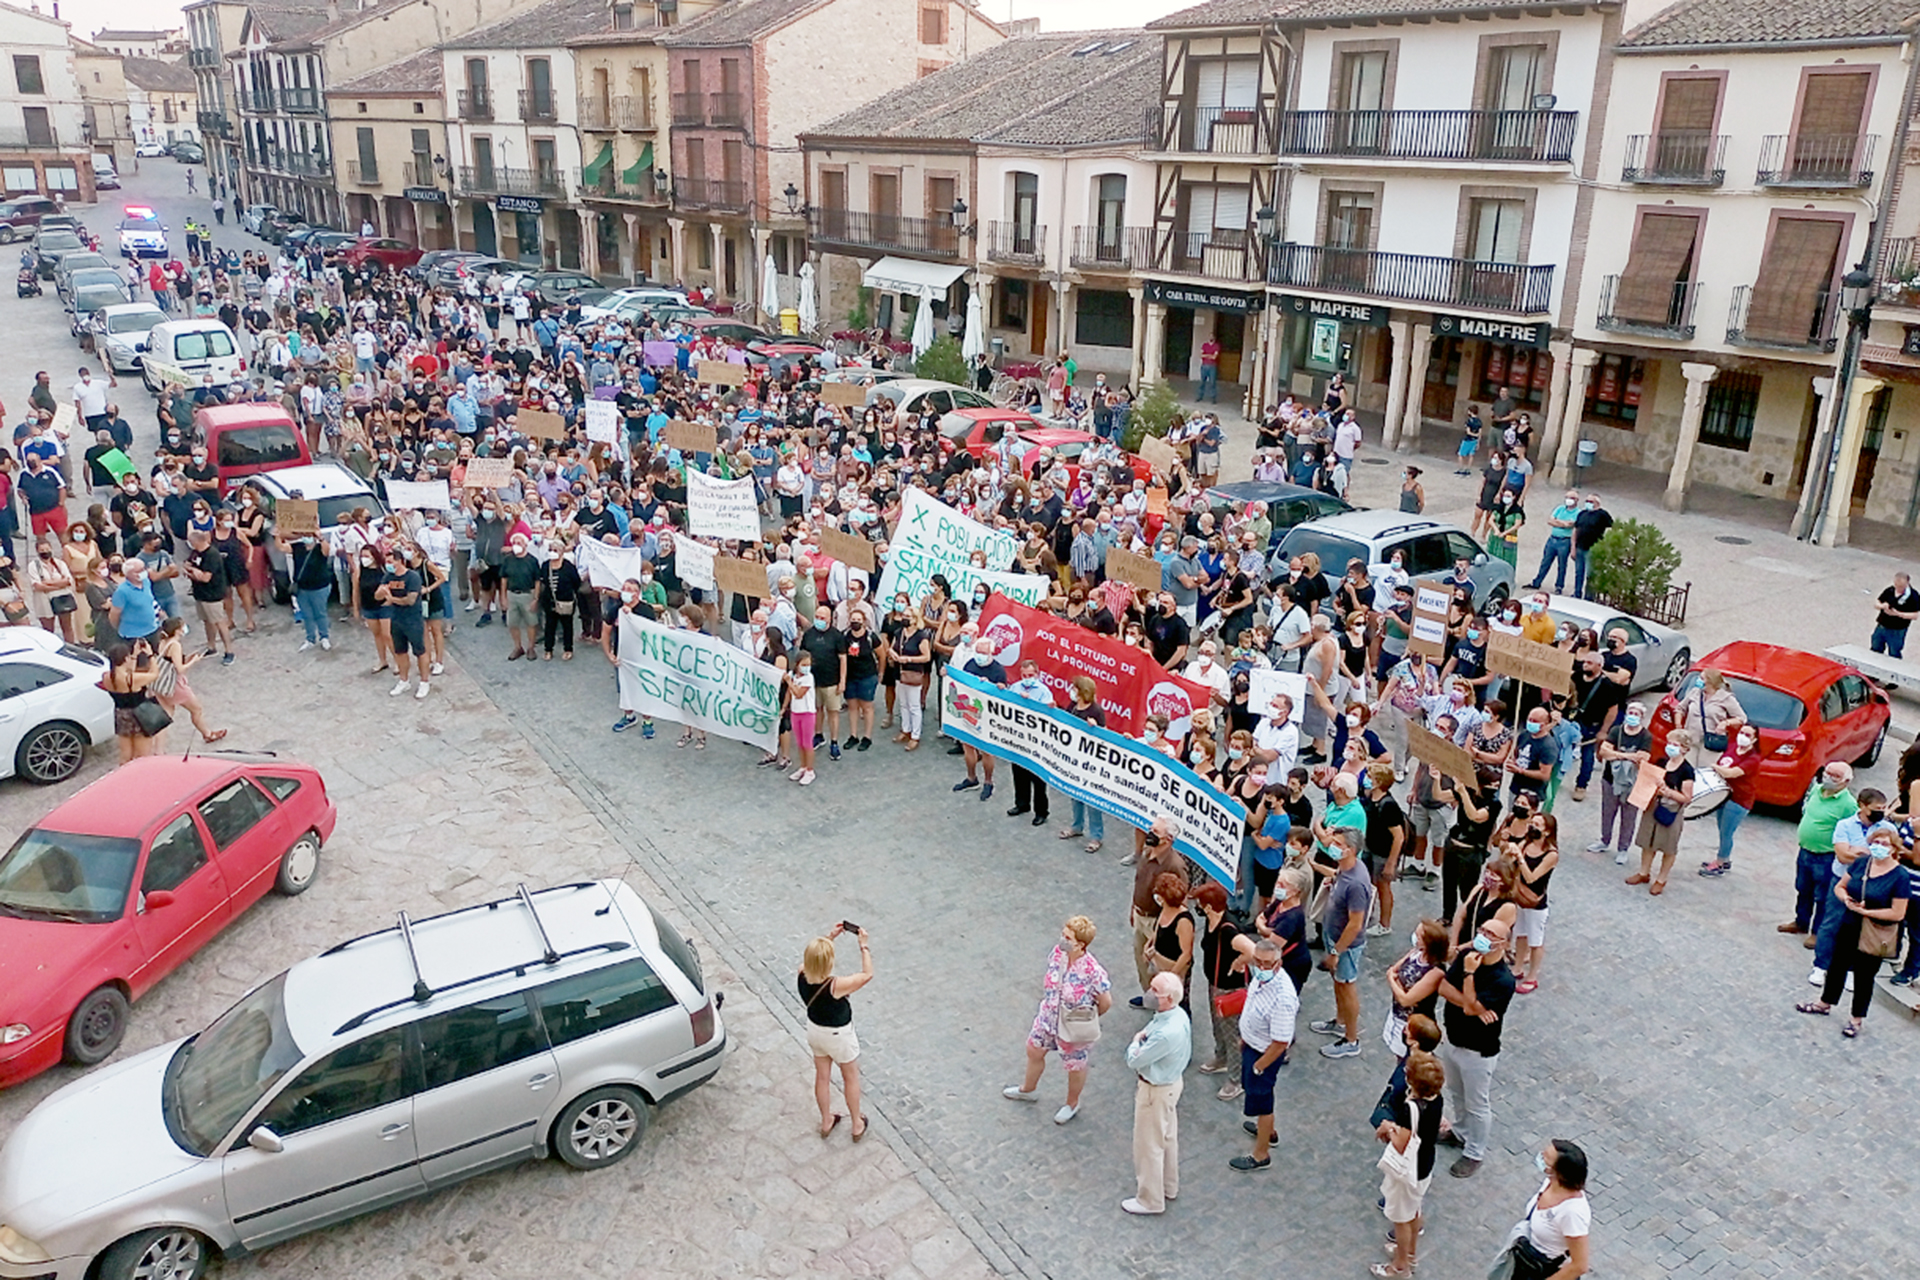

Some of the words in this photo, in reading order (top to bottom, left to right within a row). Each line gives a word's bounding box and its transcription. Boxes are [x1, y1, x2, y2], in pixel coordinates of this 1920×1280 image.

[500, 196, 539, 209] ESTANCO
[1165, 290, 1184, 301] CAJA
[1184, 292, 1209, 304] RURAL
[1209, 295, 1247, 308] SEGOVIA
[1310, 300, 1372, 321] MAPFRE
[1459, 318, 1537, 343] MAPFRE
[1036, 629, 1056, 643] POR
[1060, 637, 1071, 650] EL
[1075, 643, 1116, 667] FUTURO
[1121, 662, 1137, 676] DE
[1047, 648, 1060, 660] LA
[1062, 654, 1118, 685] PROVINCIA
[1040, 671, 1074, 693] EGOV
[1101, 698, 1132, 720] UNA
[987, 699, 1072, 746] NUESTRO
[1159, 773, 1181, 799] SE
[1184, 789, 1239, 842] QUEDA
[989, 731, 999, 743] En
[1032, 749, 1041, 759] de
[1082, 777, 1089, 787] y
[989, 718, 1025, 740] Contra
[1027, 732, 1039, 744] la
[1041, 740, 1079, 766] reforma
[1082, 761, 1097, 774] de
[1099, 766, 1111, 779] la
[1114, 775, 1159, 802] sanidad
[1160, 797, 1184, 819] rural
[1186, 814, 1201, 828] de
[1202, 822, 1211, 836] la
